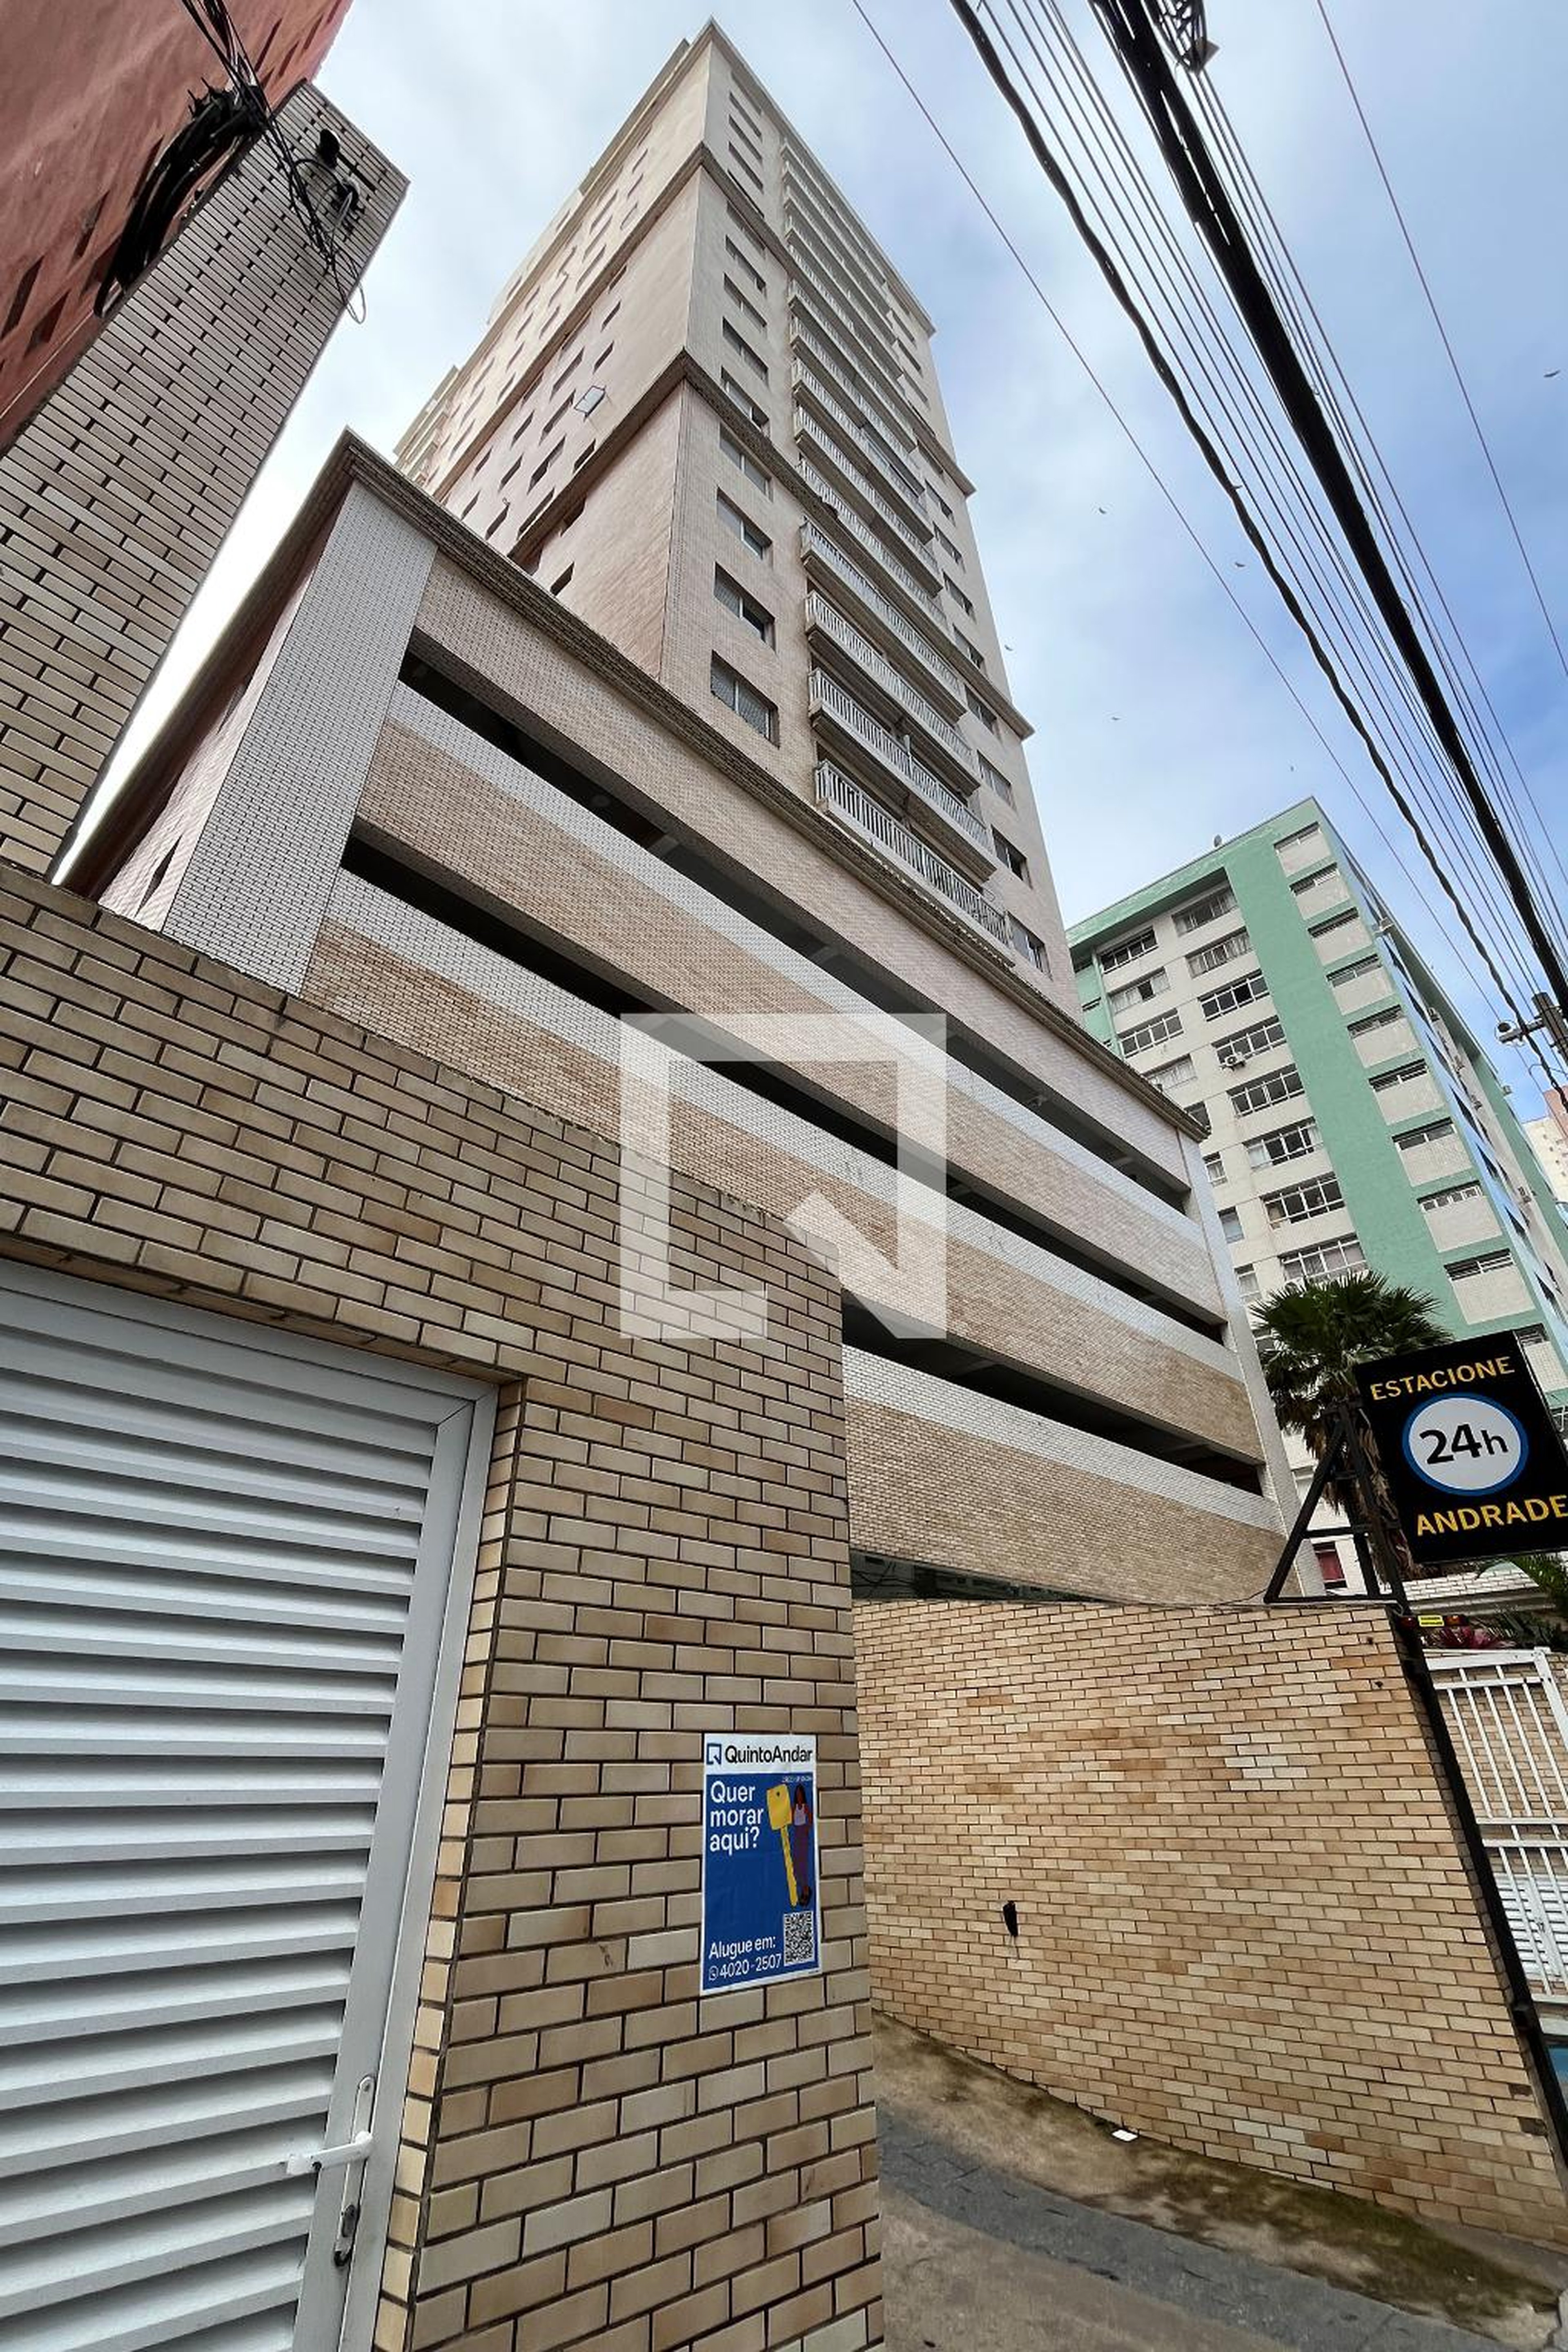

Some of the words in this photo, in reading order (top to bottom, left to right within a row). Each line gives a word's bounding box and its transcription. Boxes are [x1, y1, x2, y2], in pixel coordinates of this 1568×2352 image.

[1370, 1356, 1515, 1401] ESTACIONE
[1419, 1423, 1509, 1465] 24h
[1417, 1494, 1568, 1536] ANDRADE
[725, 1745, 813, 1764] QuintoAndar
[710, 1780, 755, 1804] Quer
[710, 1808, 764, 1827] morar
[710, 1826, 760, 1856] aqui?
[708, 1940, 753, 1960] Alugue
[755, 1936, 776, 1951] em:
